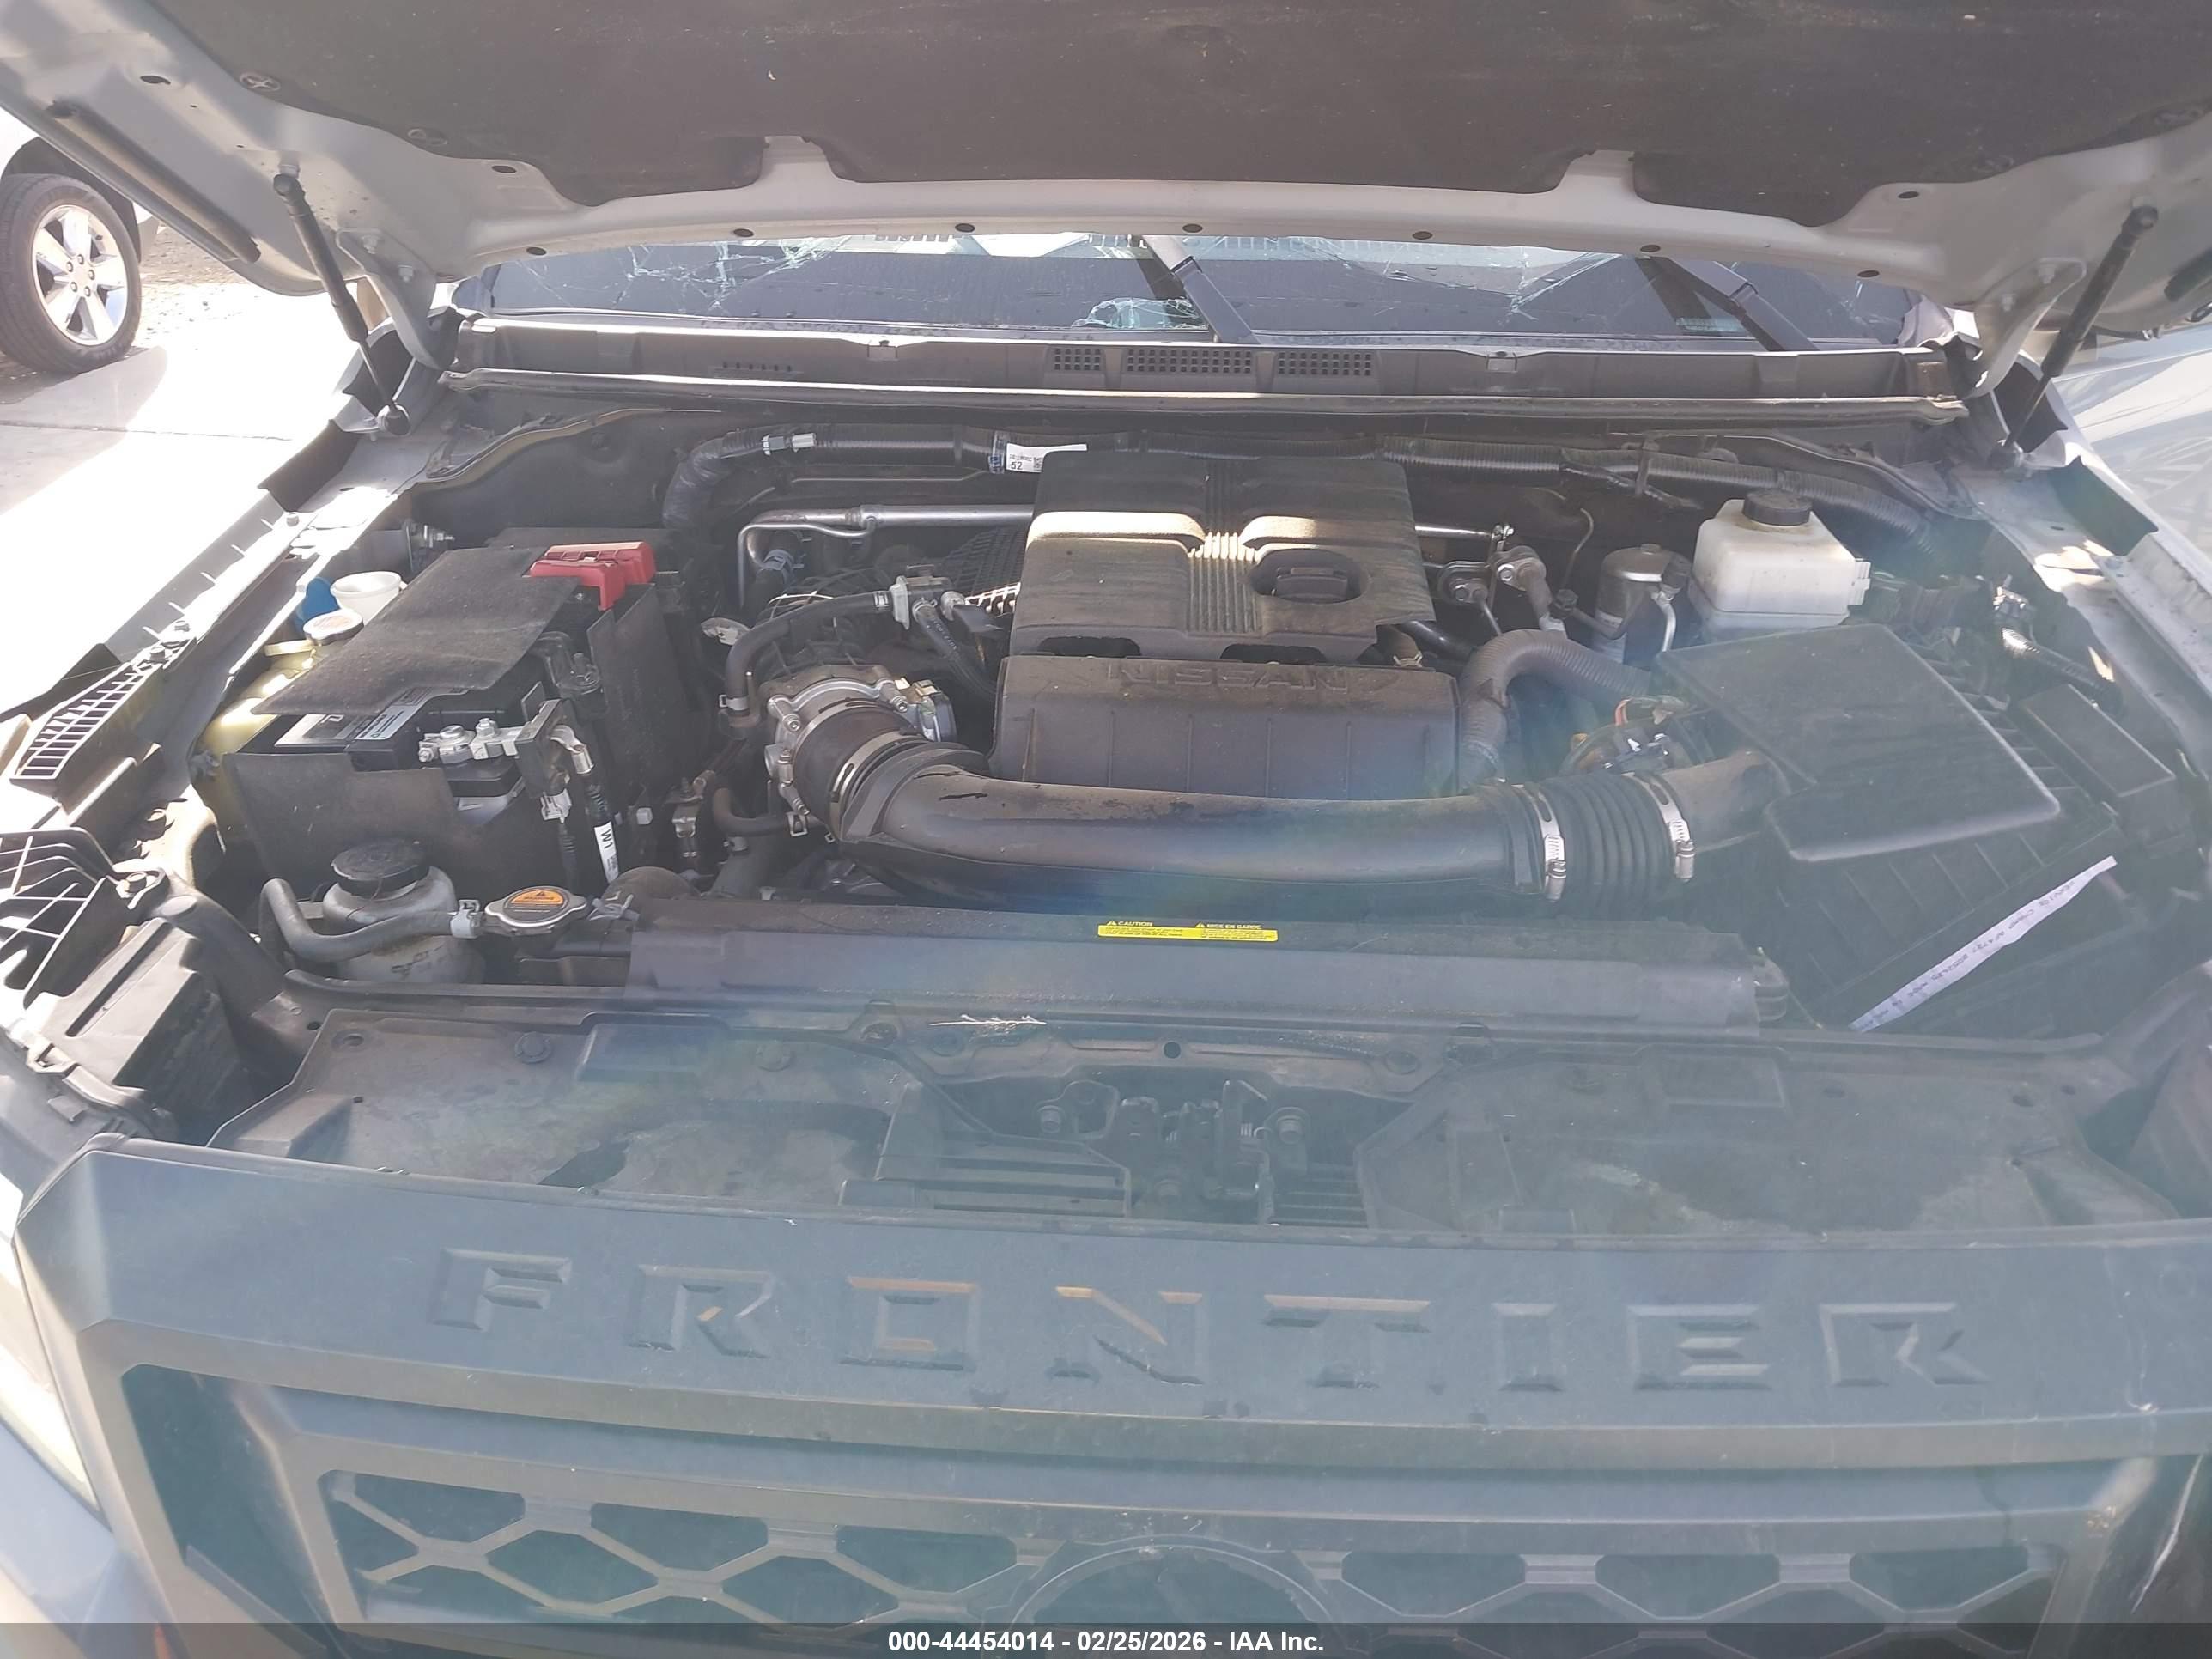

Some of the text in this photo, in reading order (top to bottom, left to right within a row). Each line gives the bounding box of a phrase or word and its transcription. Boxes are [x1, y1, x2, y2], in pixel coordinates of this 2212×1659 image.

[1010, 461, 1023, 471] 52
[1107, 663, 1349, 694] NISSAN
[600, 828, 614, 849] W1
[429, 1248, 1990, 1393] FRONTIER
